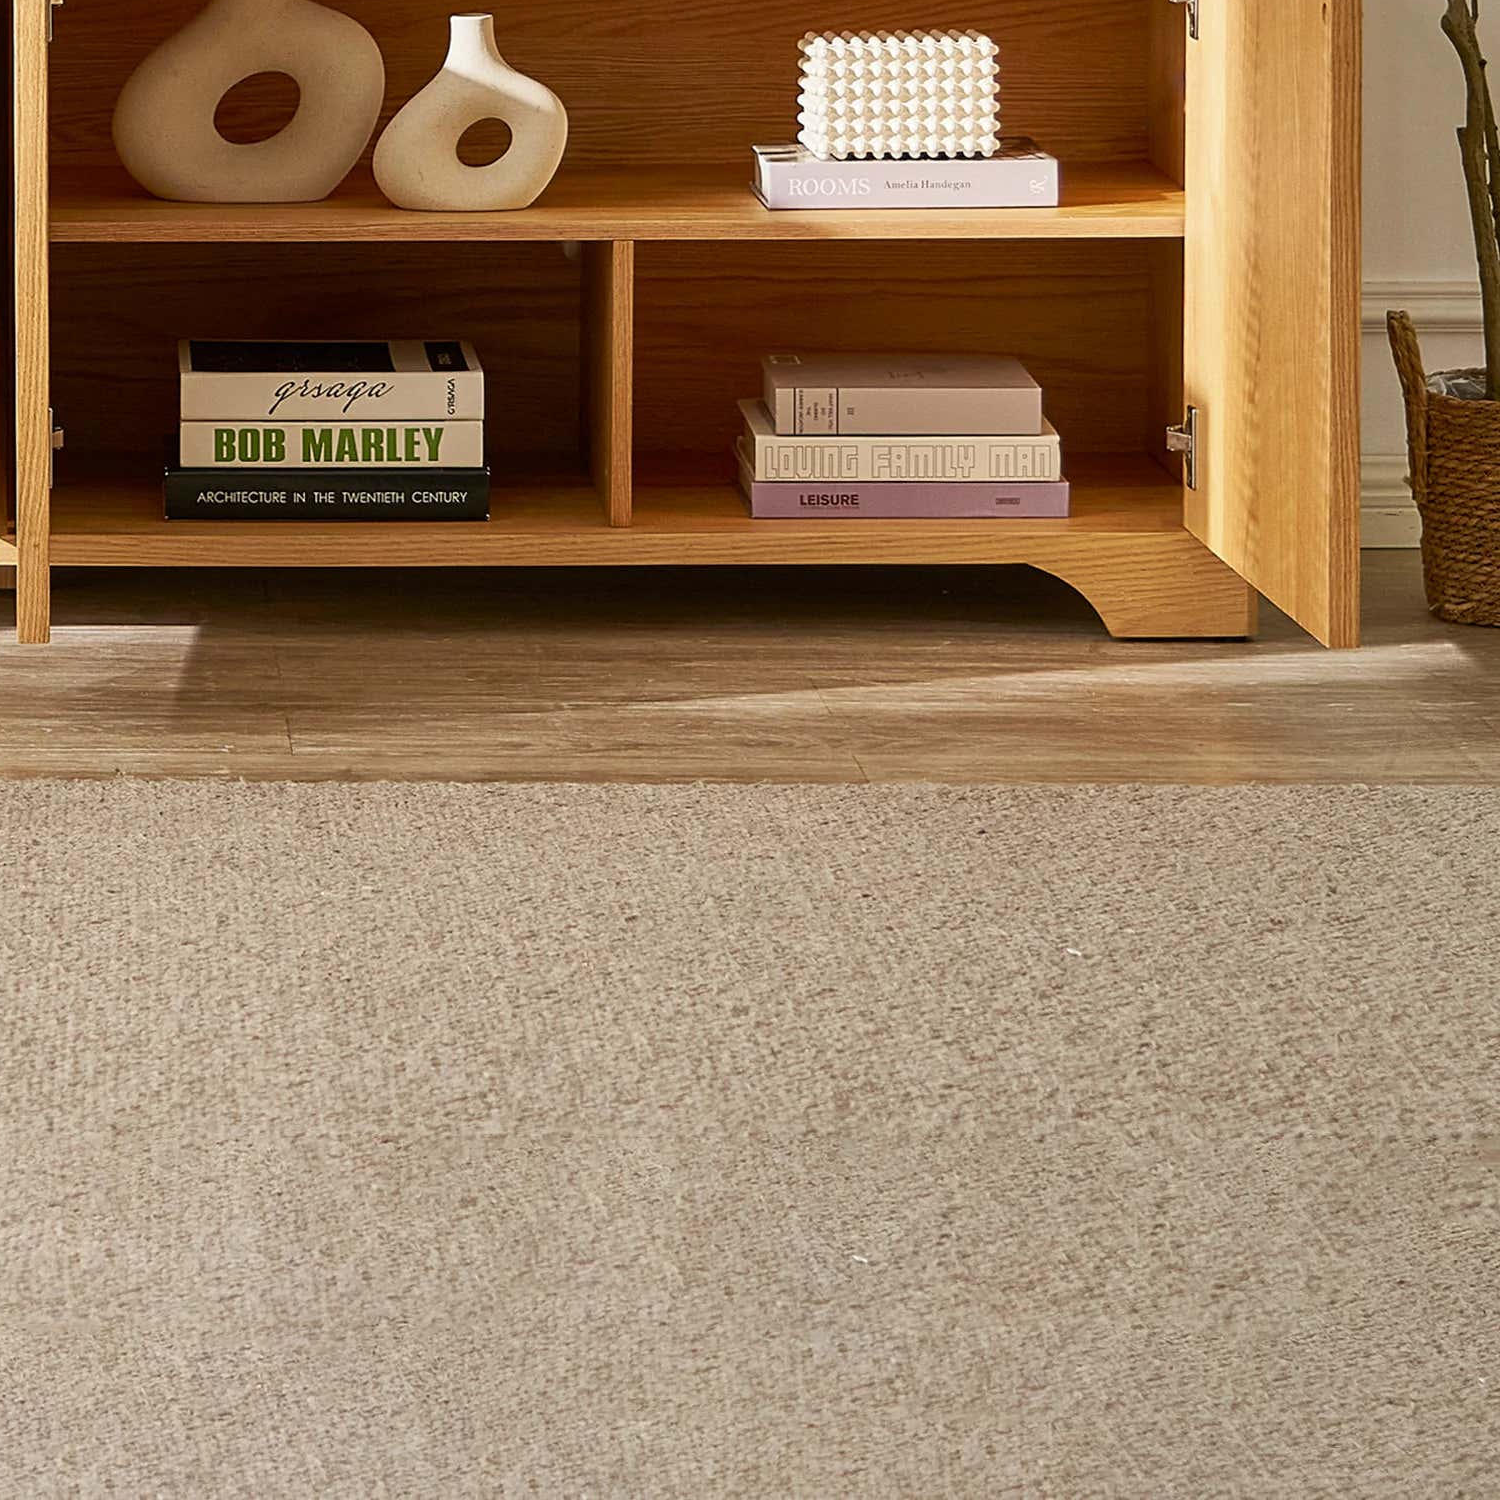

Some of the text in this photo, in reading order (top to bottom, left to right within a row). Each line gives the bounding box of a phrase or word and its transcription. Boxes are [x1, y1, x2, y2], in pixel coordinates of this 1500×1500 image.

[788, 178, 972, 196] ROOMS Amelia Handegan
[268, 378, 395, 415] grsaga
[214, 427, 445, 463] BOB MARLEY
[764, 445, 1052, 479] LOVING FAMILY MAN
[196, 491, 468, 504] ARCHITECTURE IN THE TWENTIETH CENTURY
[799, 494, 860, 506] LEISURE
